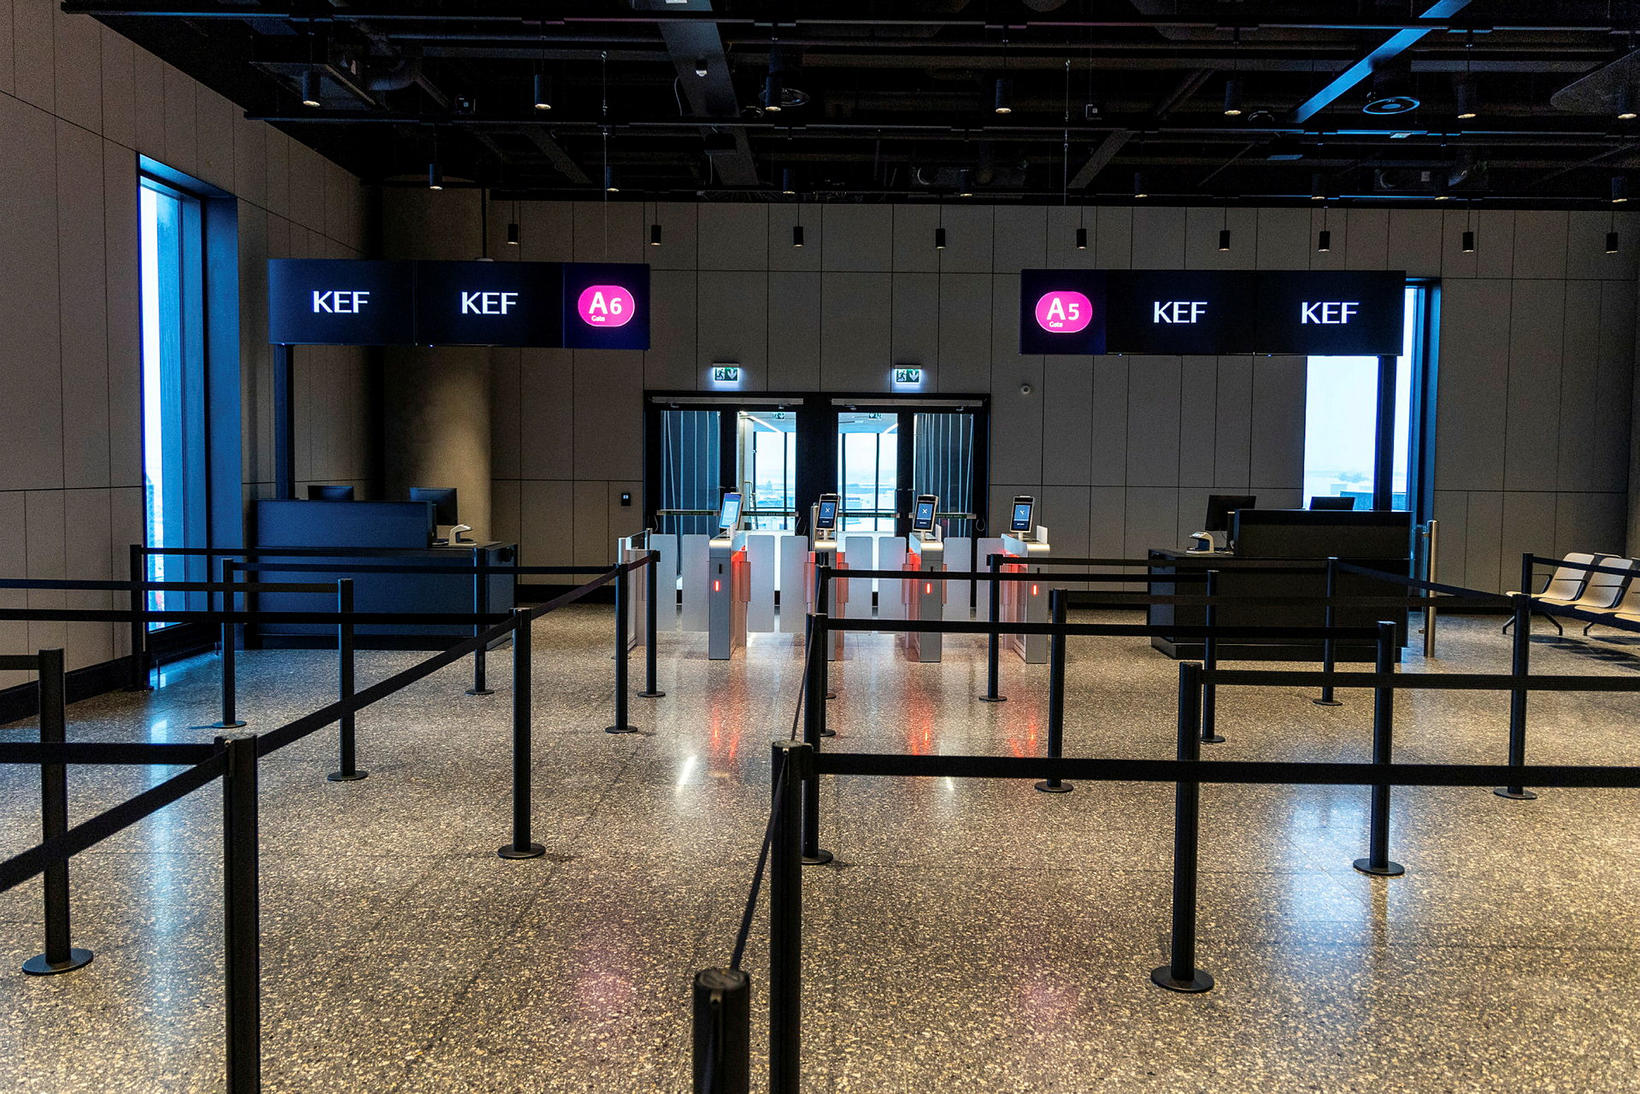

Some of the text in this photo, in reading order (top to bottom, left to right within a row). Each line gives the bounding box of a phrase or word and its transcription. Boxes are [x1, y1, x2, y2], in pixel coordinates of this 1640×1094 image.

[312, 290, 370, 314] KEF
[461, 291, 519, 315] KEF
[588, 291, 623, 315] A6
[1046, 297, 1080, 321] A5
[1153, 301, 1208, 324] KEF
[1301, 301, 1359, 324] KEF
